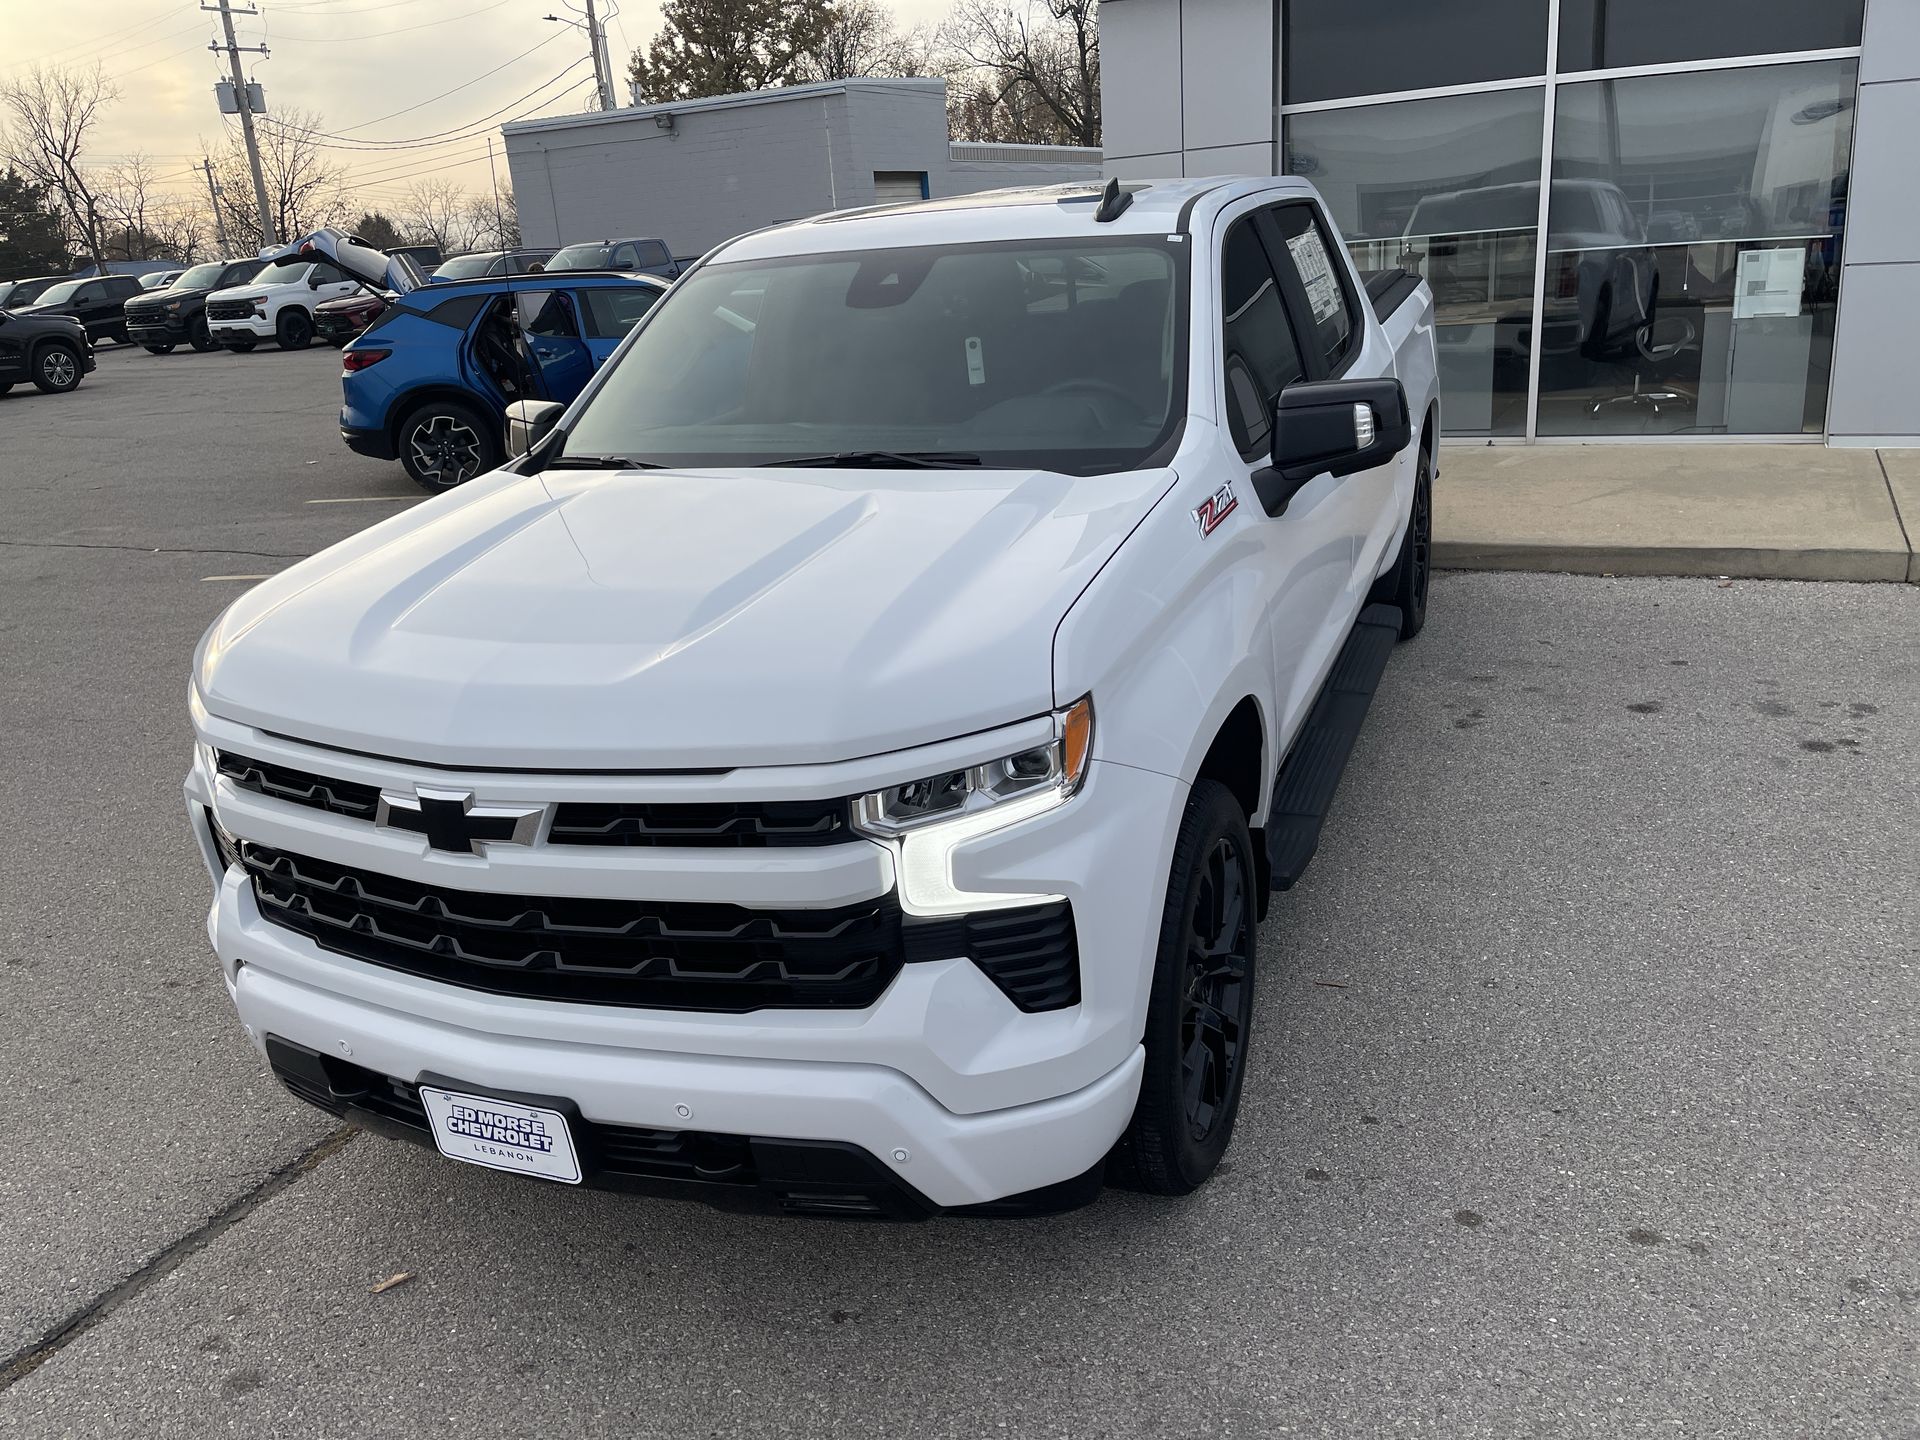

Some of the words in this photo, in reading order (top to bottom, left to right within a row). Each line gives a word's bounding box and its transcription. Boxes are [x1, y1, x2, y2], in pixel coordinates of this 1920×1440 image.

[1190, 480, 1239, 540] Z71
[447, 1116, 553, 1153] CHEVROLET
[452, 1105, 477, 1121] ED
[478, 1110, 544, 1136] MORSE
[474, 1143, 534, 1162] LEBANON
